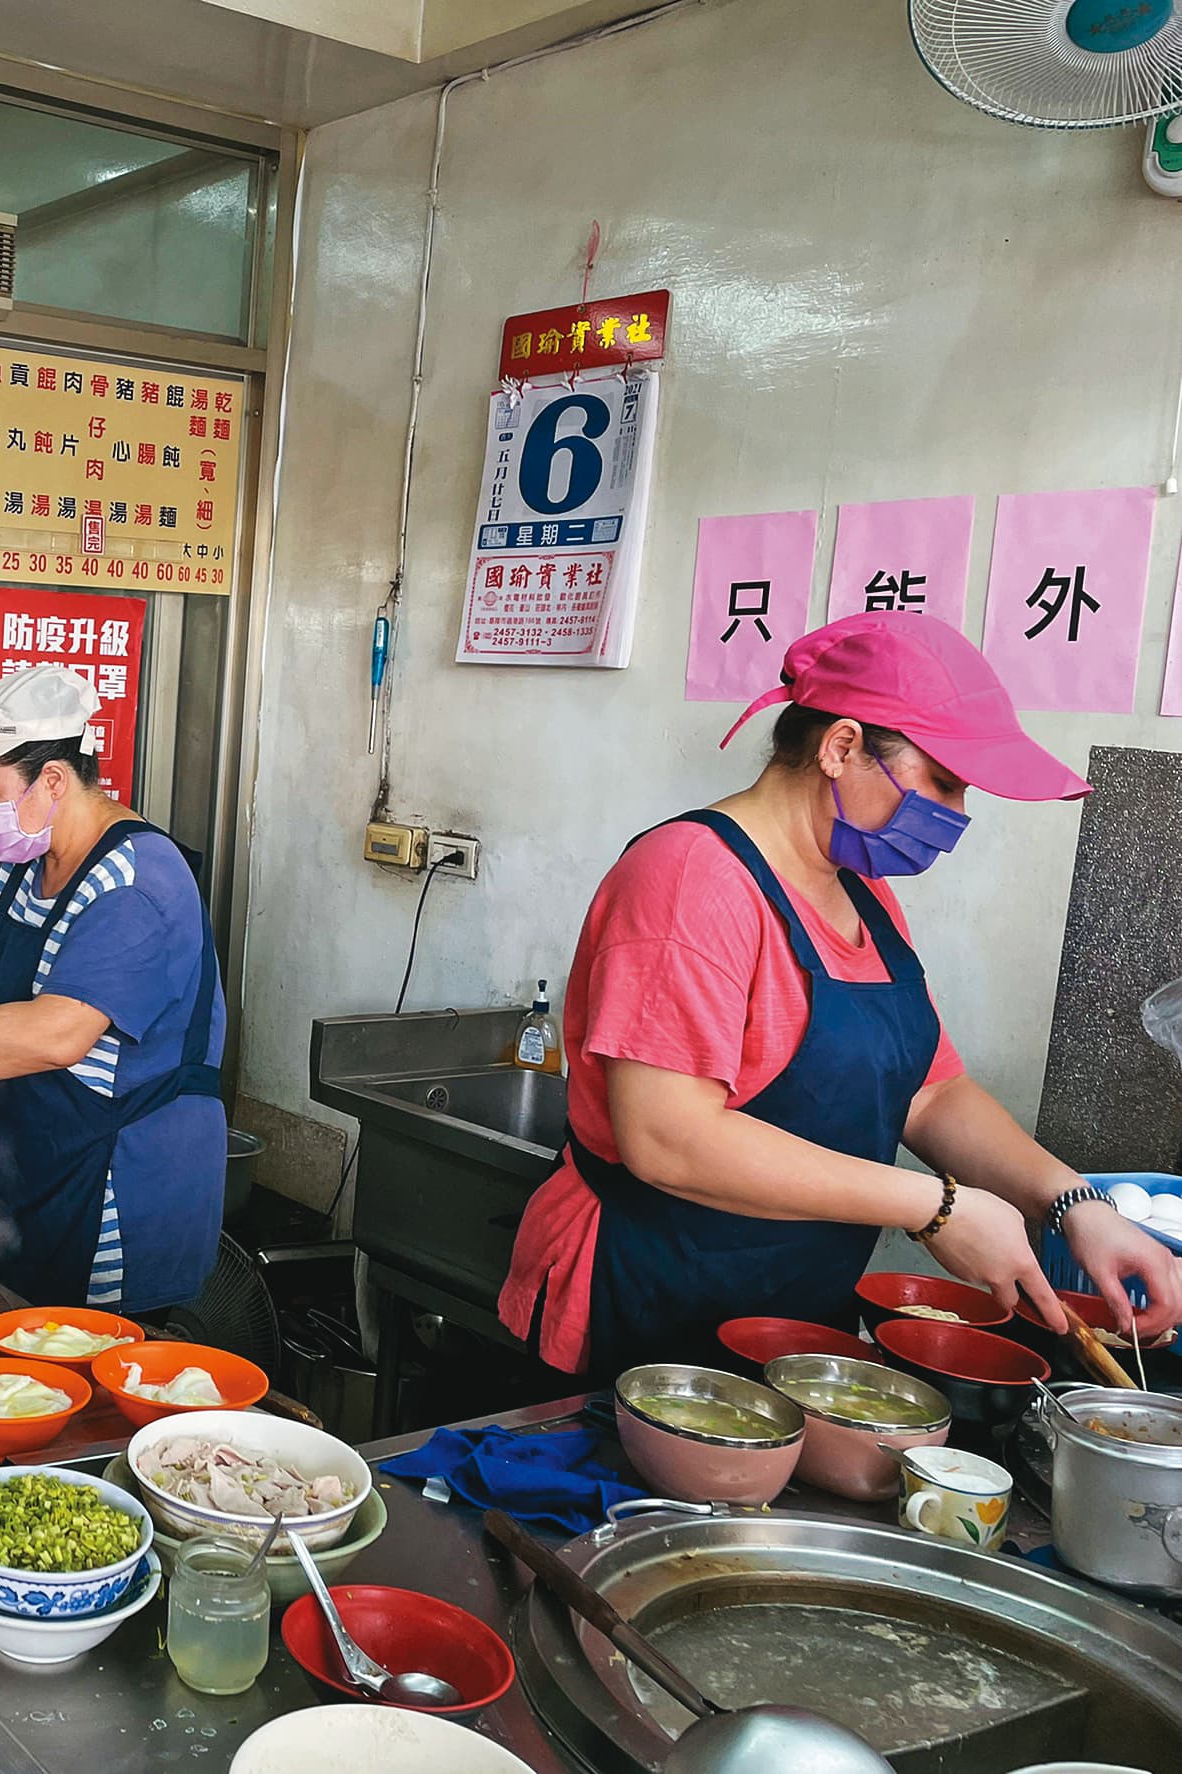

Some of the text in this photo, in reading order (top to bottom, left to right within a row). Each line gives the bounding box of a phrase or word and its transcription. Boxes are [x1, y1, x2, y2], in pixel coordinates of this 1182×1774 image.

[511, 313, 652, 360] 國瑜實業社
[189, 389, 208, 438] 湯麵
[624, 383, 642, 395] 2021
[624, 404, 635, 420] 7
[4, 363, 30, 515] 貢丸湯
[213, 392, 233, 441] 乾麵
[31, 367, 56, 517] 餛飩湯
[57, 371, 83, 520] 肉片湯
[109, 378, 134, 524] 豬心湯
[134, 381, 159, 526] 豬腸湯
[158, 384, 184, 528] 餛飩麵
[518, 393, 611, 516] 6
[487, 449, 510, 522] 五月廿七日
[197, 544, 208, 559] 中
[213, 545, 224, 560] 小
[516, 524, 585, 545] 星期二
[2, 552, 20, 570] 25
[29, 554, 47, 572] 30
[56, 556, 73, 574] 35
[82, 558, 99, 576] 40
[107, 560, 124, 577] 40
[132, 561, 149, 579] 40
[156, 563, 173, 581] 60
[178, 566, 190, 582] 60
[195, 568, 207, 583] 45
[211, 569, 223, 584] 30
[484, 563, 603, 590] 國瑜實業社
[720, 579, 773, 643] 只
[1024, 565, 1102, 643] 外
[2, 612, 130, 656] 防疫升級
[2, 659, 128, 700] 口罩
